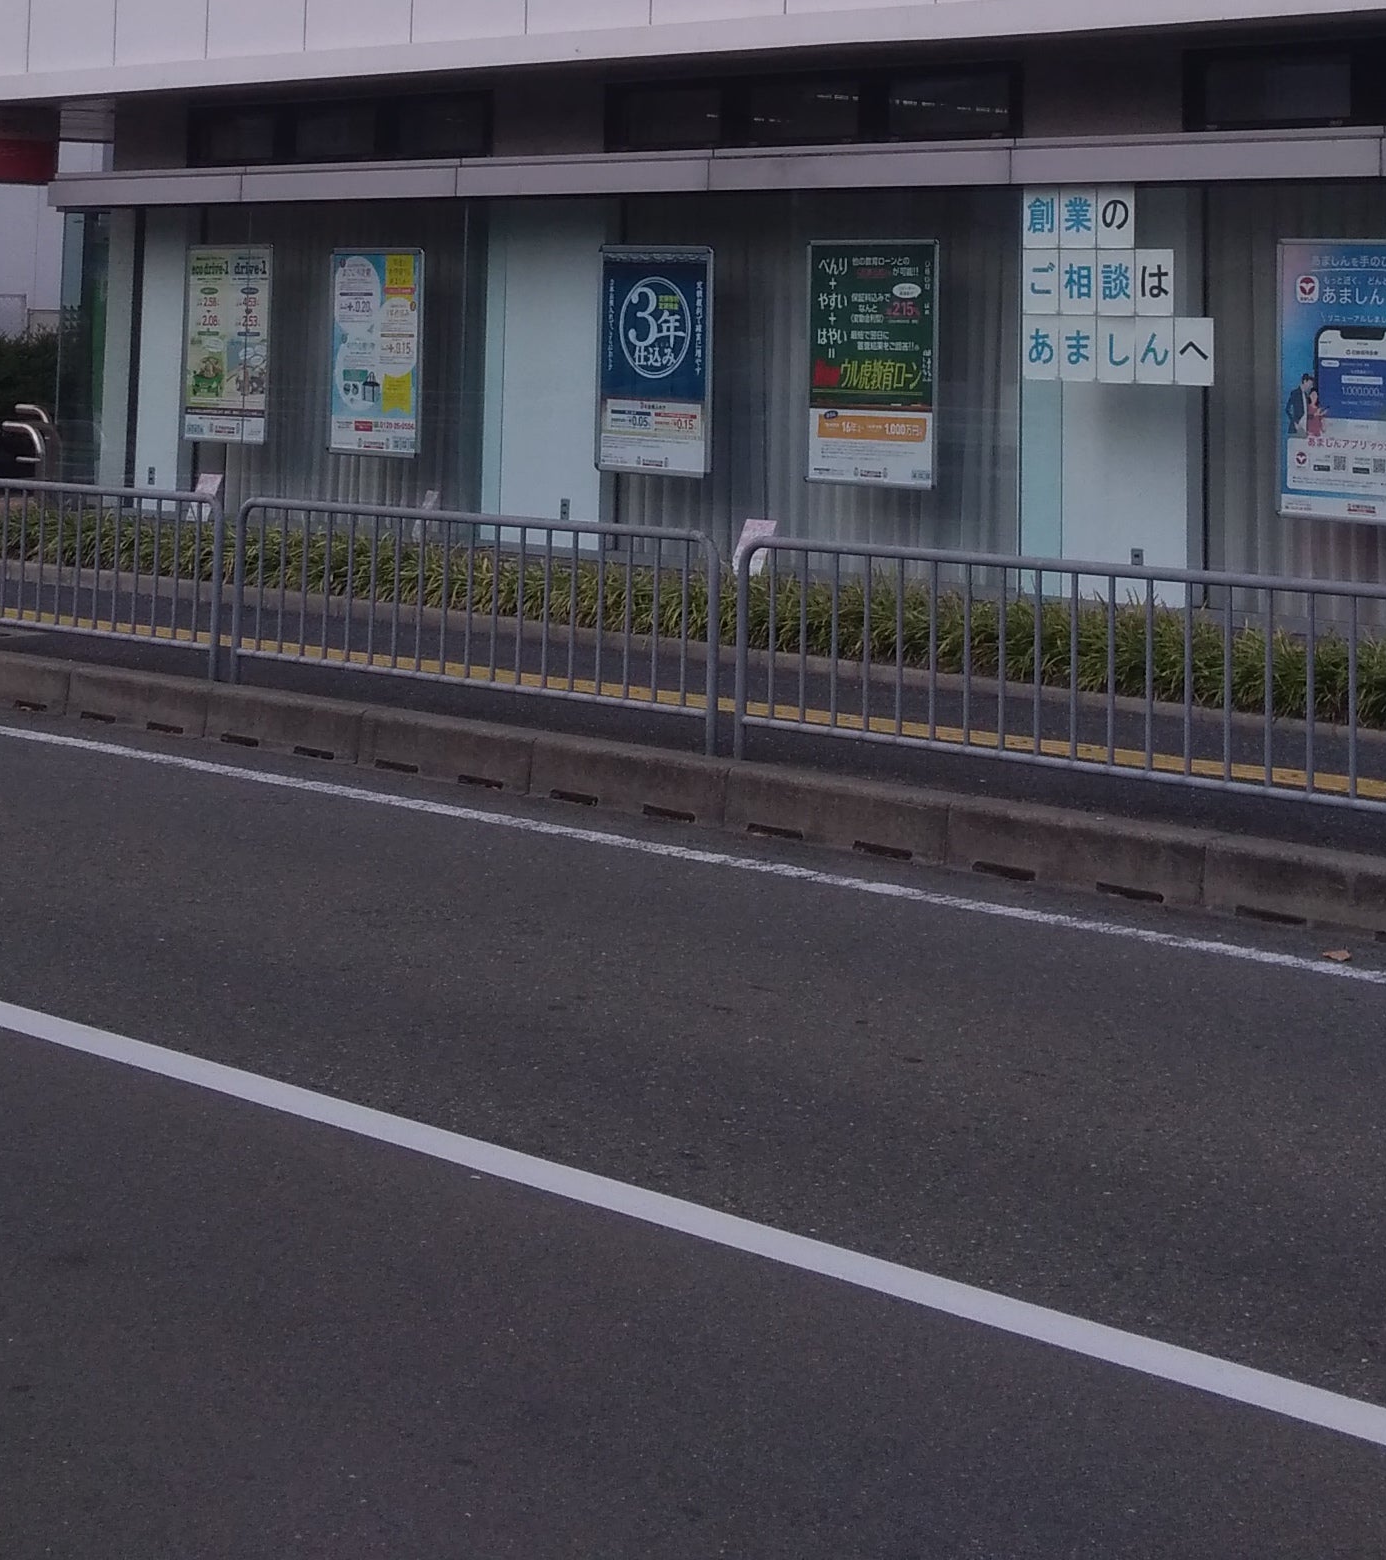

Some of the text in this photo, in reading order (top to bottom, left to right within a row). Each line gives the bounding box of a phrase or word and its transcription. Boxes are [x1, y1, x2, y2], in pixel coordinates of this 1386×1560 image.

[1027, 196, 1129, 234] 創業の
[818, 257, 848, 275] べんり
[1031, 262, 1169, 300] ご相談は
[818, 292, 848, 310] やすい
[817, 328, 848, 345] はやい
[1028, 328, 1209, 367] あましんへ
[633, 346, 677, 367] 仕込み
[840, 358, 922, 391] ウル虎教育ローン
